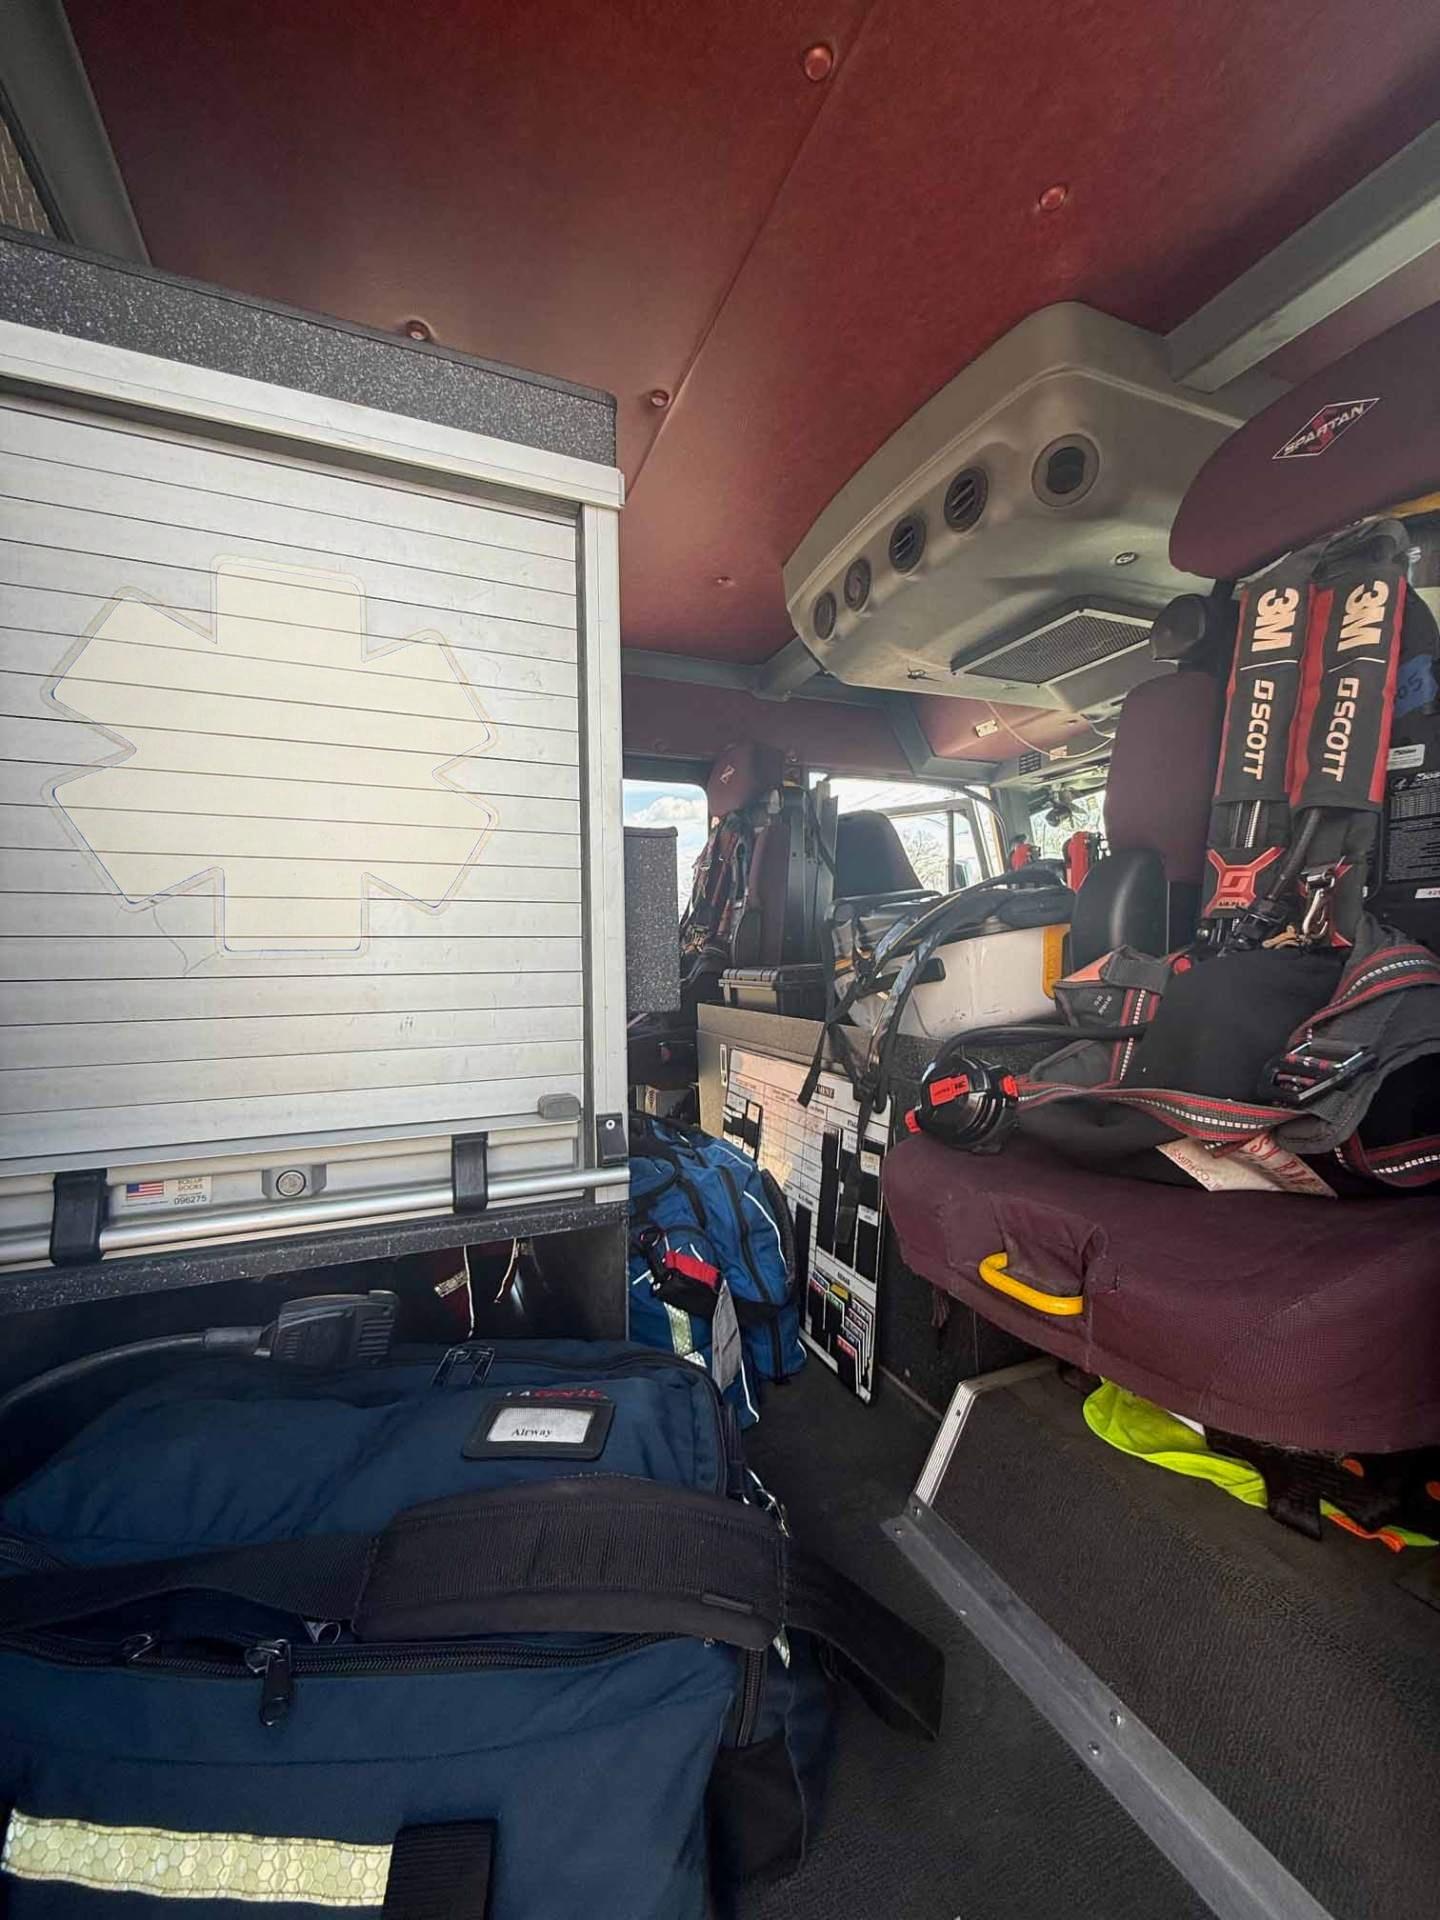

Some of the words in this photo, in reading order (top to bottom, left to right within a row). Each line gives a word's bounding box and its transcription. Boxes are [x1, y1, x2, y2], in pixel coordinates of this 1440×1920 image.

[1283, 403, 1364, 456] SPARTAN
[1251, 587, 1299, 652] 3M
[1336, 579, 1389, 652] 3M
[1242, 702, 1271, 780] SCOTT
[1321, 701, 1356, 782] SCOTT
[512, 1427, 553, 1438] Airway
